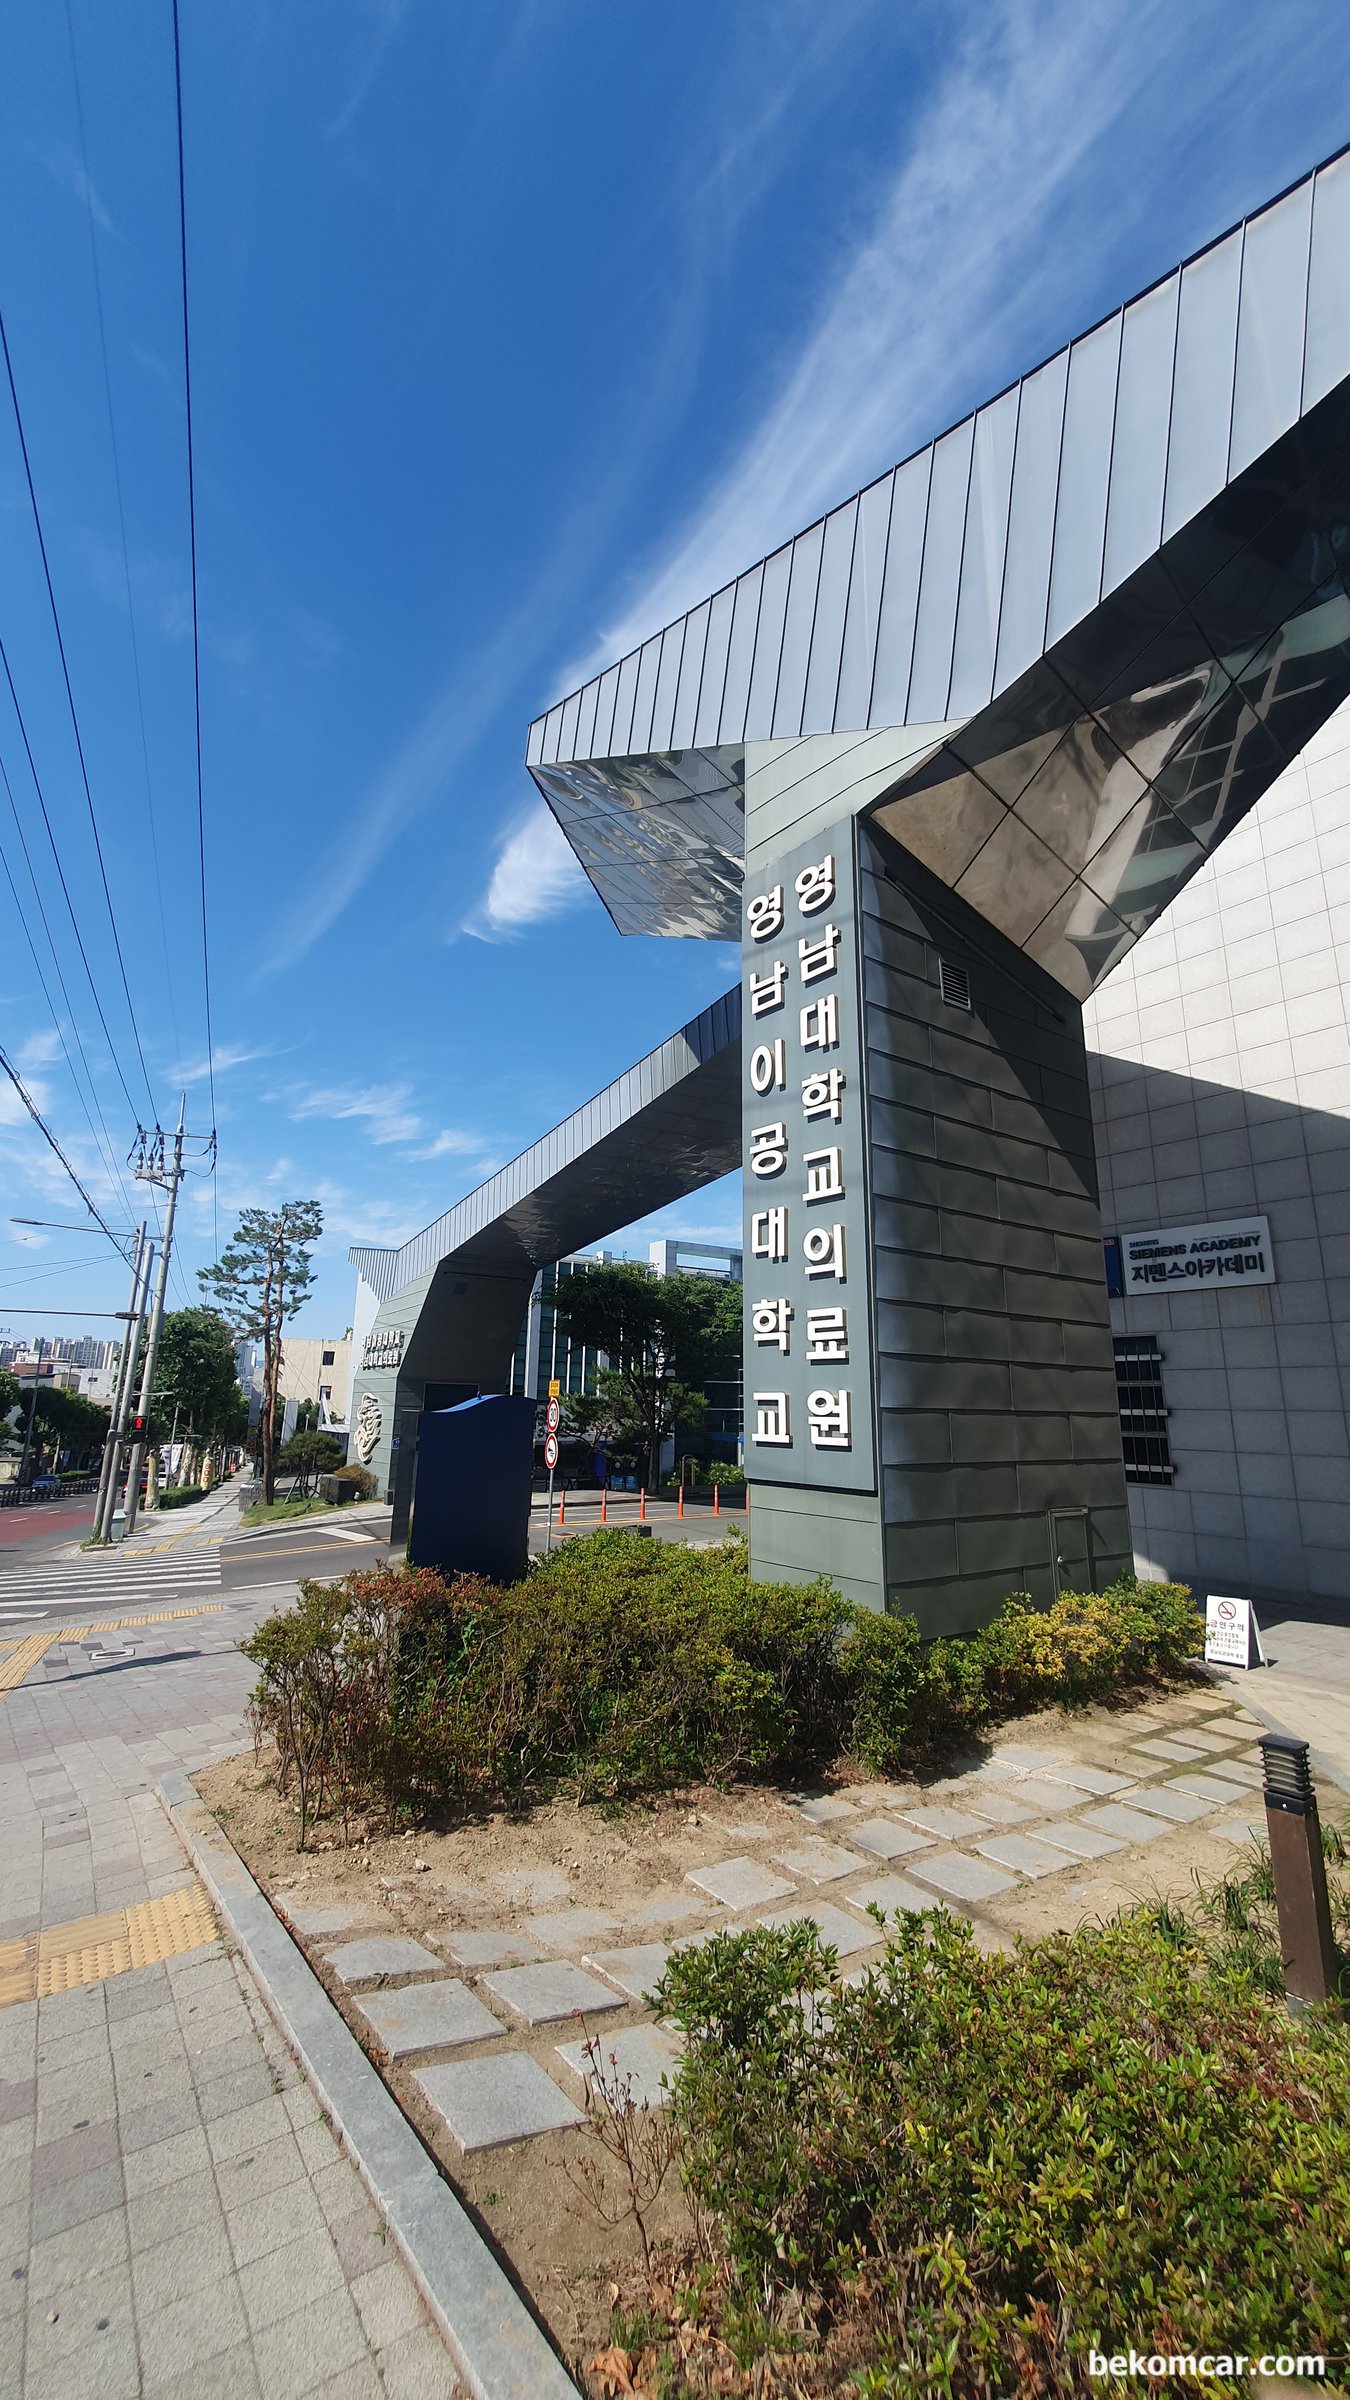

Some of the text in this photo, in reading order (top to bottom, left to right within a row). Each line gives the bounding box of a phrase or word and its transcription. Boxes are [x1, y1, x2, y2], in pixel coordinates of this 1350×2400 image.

[746, 884, 793, 1445] 영남이공대학교
[794, 854, 852, 1447] 영남대학교의료원
[1129, 1243, 1187, 1260] SIEMENS
[1190, 1235, 1261, 1254] ACADEMY
[1131, 1251, 1265, 1283] 지멘스아카데미
